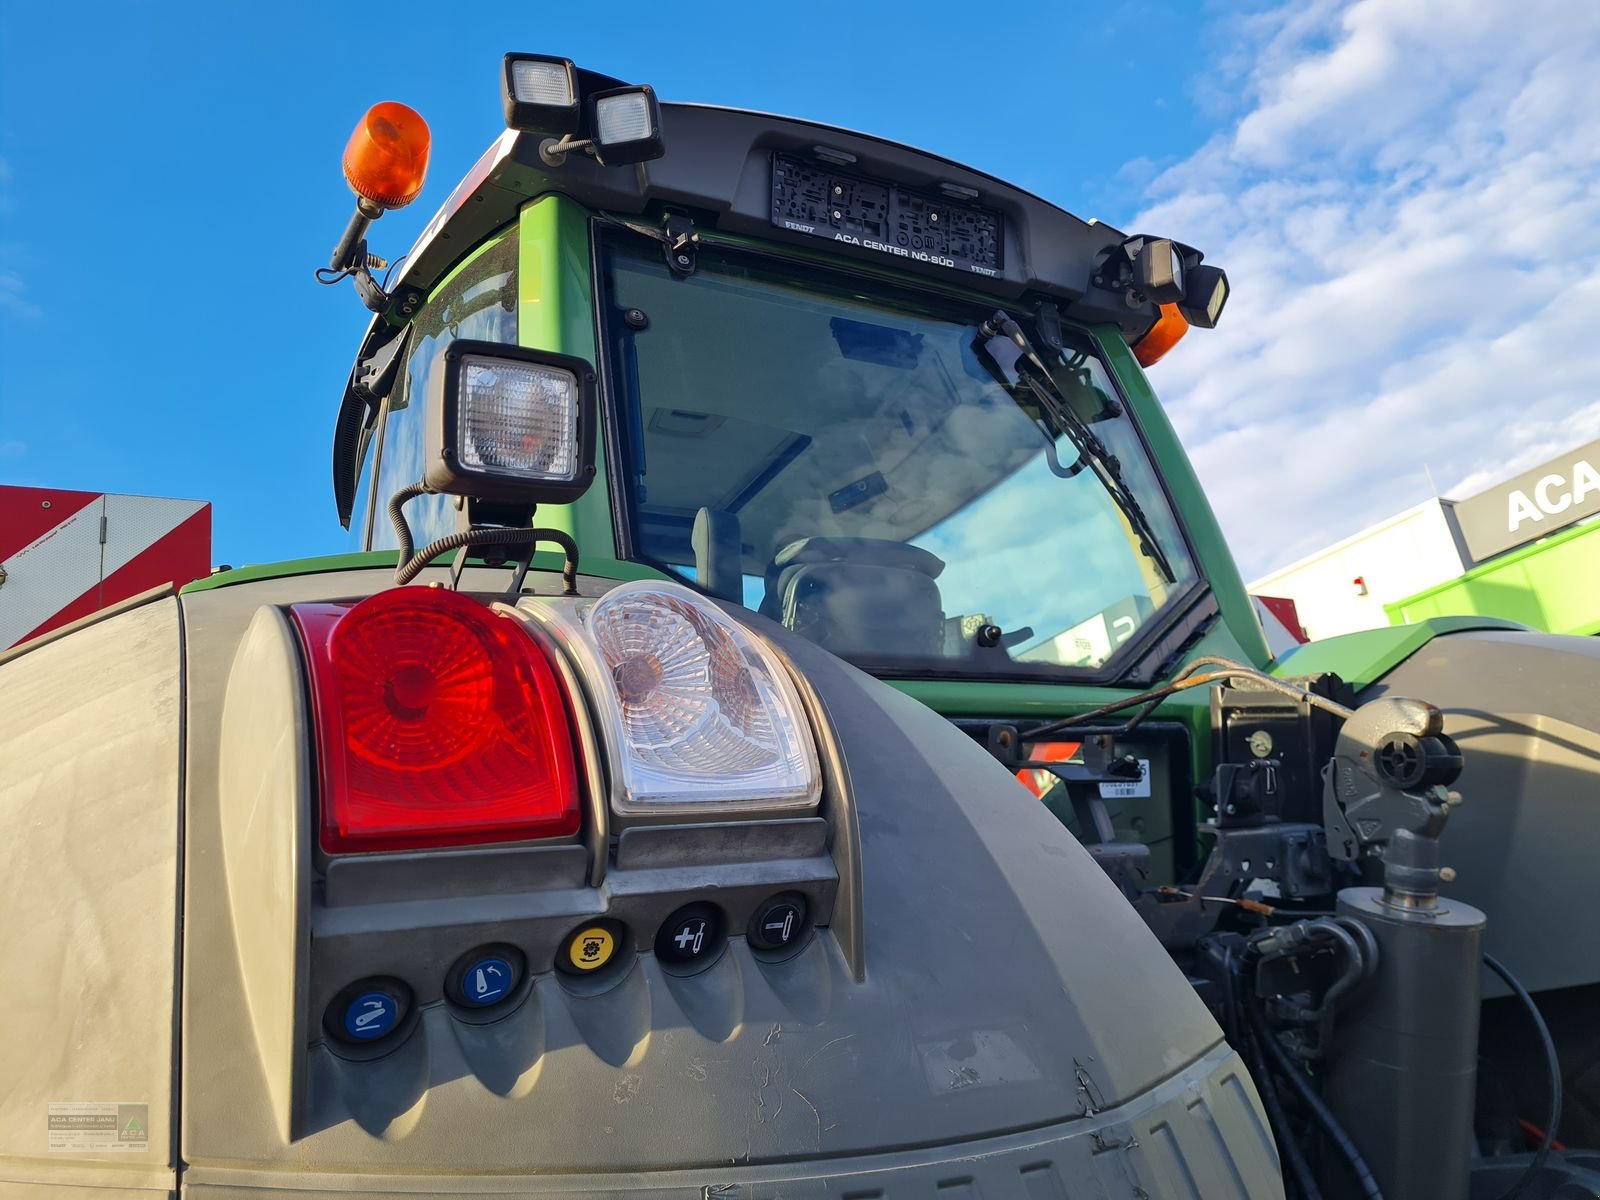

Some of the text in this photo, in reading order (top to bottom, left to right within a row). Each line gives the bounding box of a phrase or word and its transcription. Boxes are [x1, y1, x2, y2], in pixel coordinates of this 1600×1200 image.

[785, 220, 815, 233] FENDT
[834, 233, 860, 246] ACA
[863, 239, 909, 257] CENTER
[970, 264, 997, 277] FENDT
[1508, 460, 1600, 532] ACA
